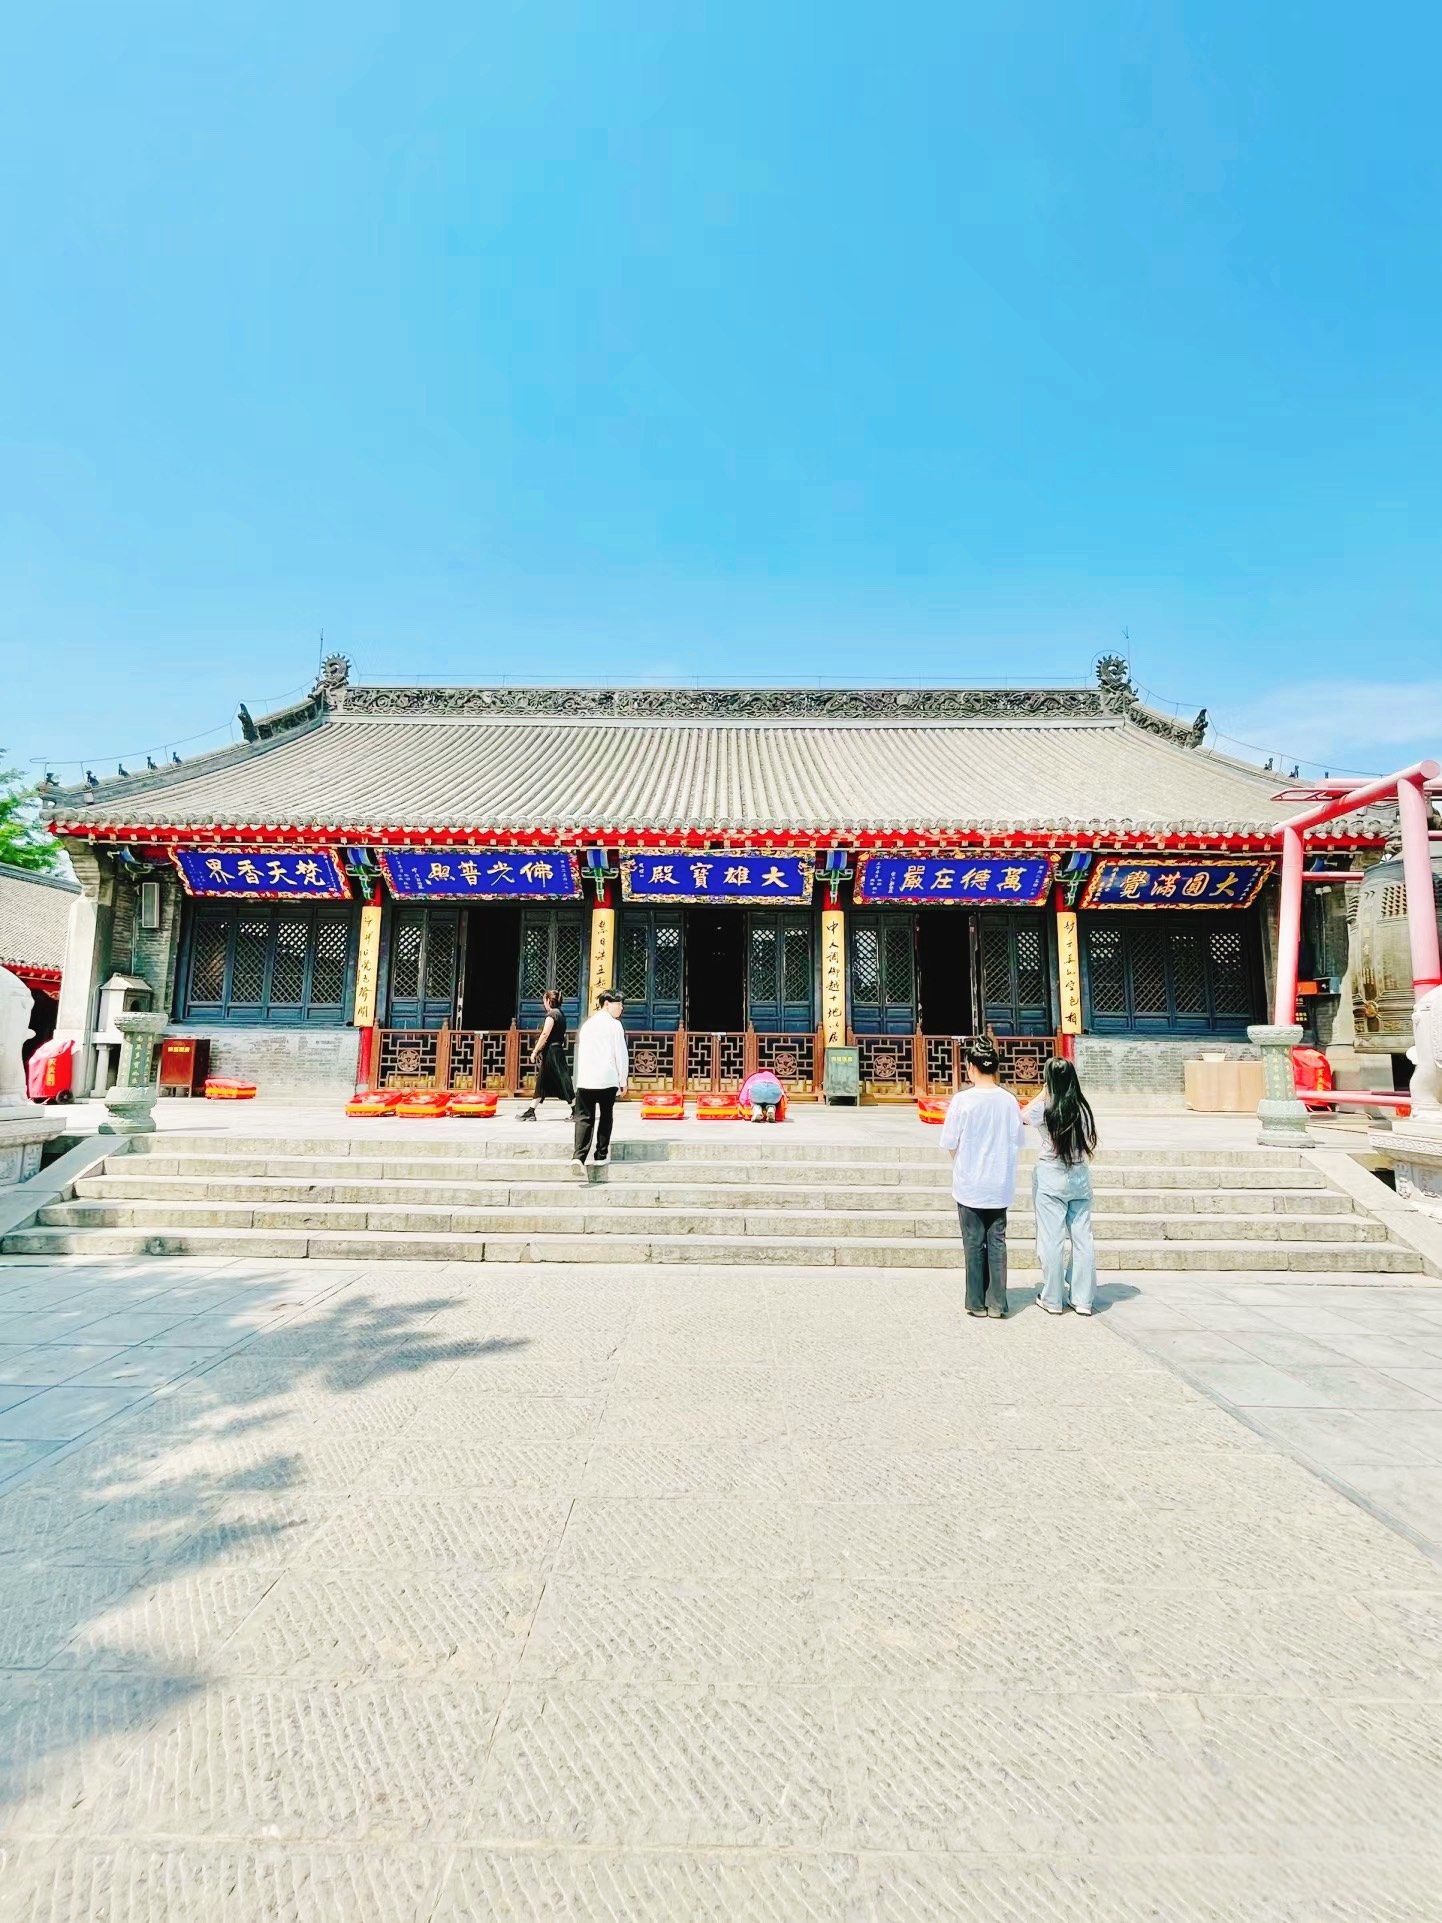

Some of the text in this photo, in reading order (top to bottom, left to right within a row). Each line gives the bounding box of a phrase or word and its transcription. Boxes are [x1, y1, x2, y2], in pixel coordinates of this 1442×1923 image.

[205, 858, 326, 886] 梵天香界
[648, 862, 789, 889] 大雄寶殿
